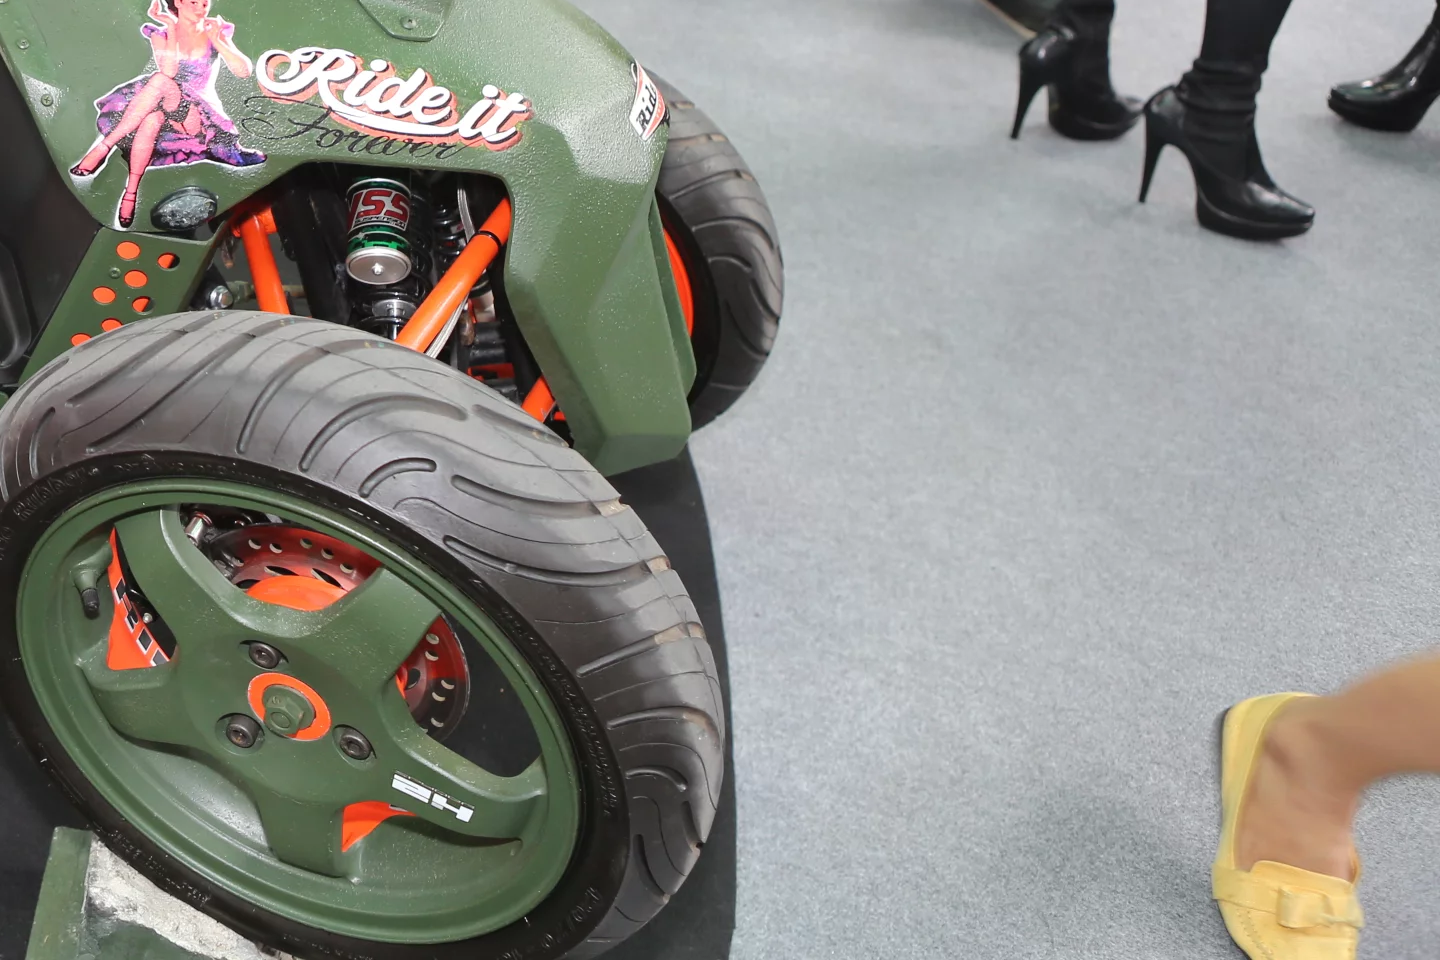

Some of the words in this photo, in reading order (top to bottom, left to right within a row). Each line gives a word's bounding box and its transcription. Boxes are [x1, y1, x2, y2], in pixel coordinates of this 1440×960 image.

[241, 95, 472, 160] Forever
[256, 46, 457, 135] Ride
[453, 84, 533, 152] it
